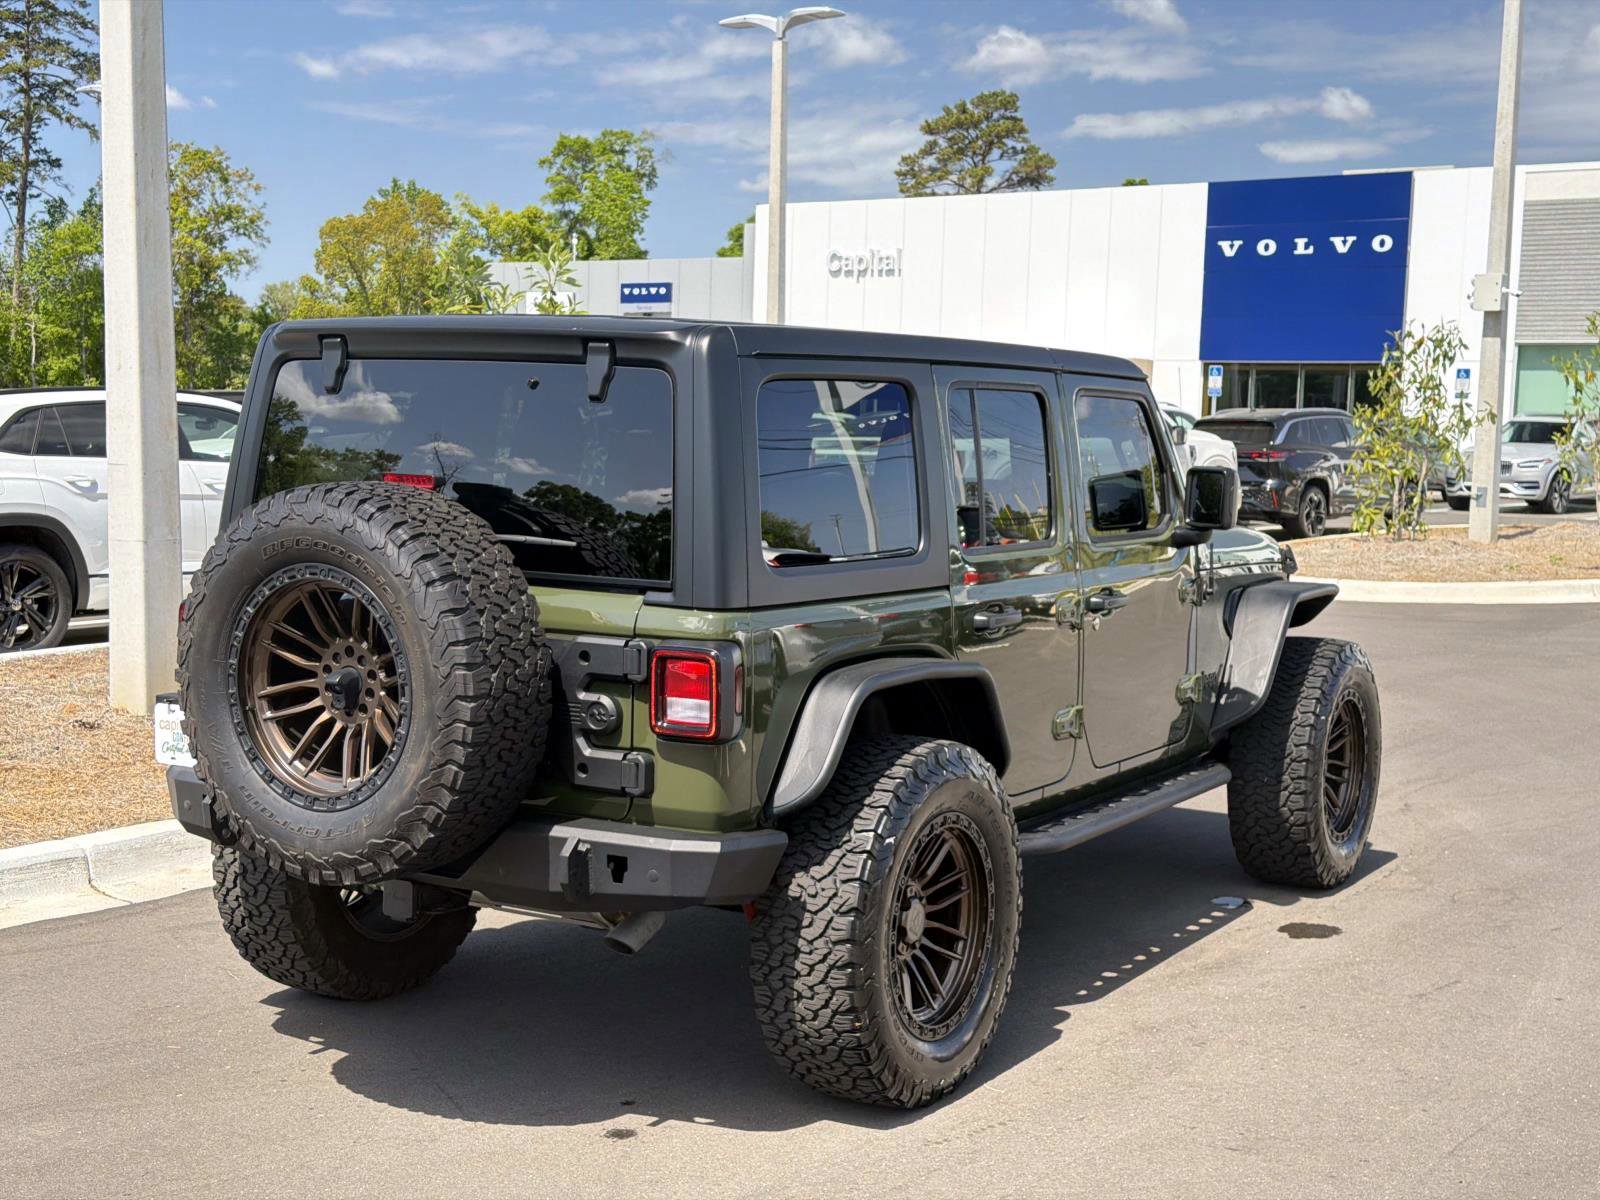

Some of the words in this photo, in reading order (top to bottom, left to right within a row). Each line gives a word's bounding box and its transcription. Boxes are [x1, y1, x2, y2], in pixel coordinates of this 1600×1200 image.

[1217, 234, 1394, 257] VOLVO
[826, 247, 903, 283] Capital
[622, 286, 667, 295] VOLVO
[261, 535, 408, 625] BFGoodrich
